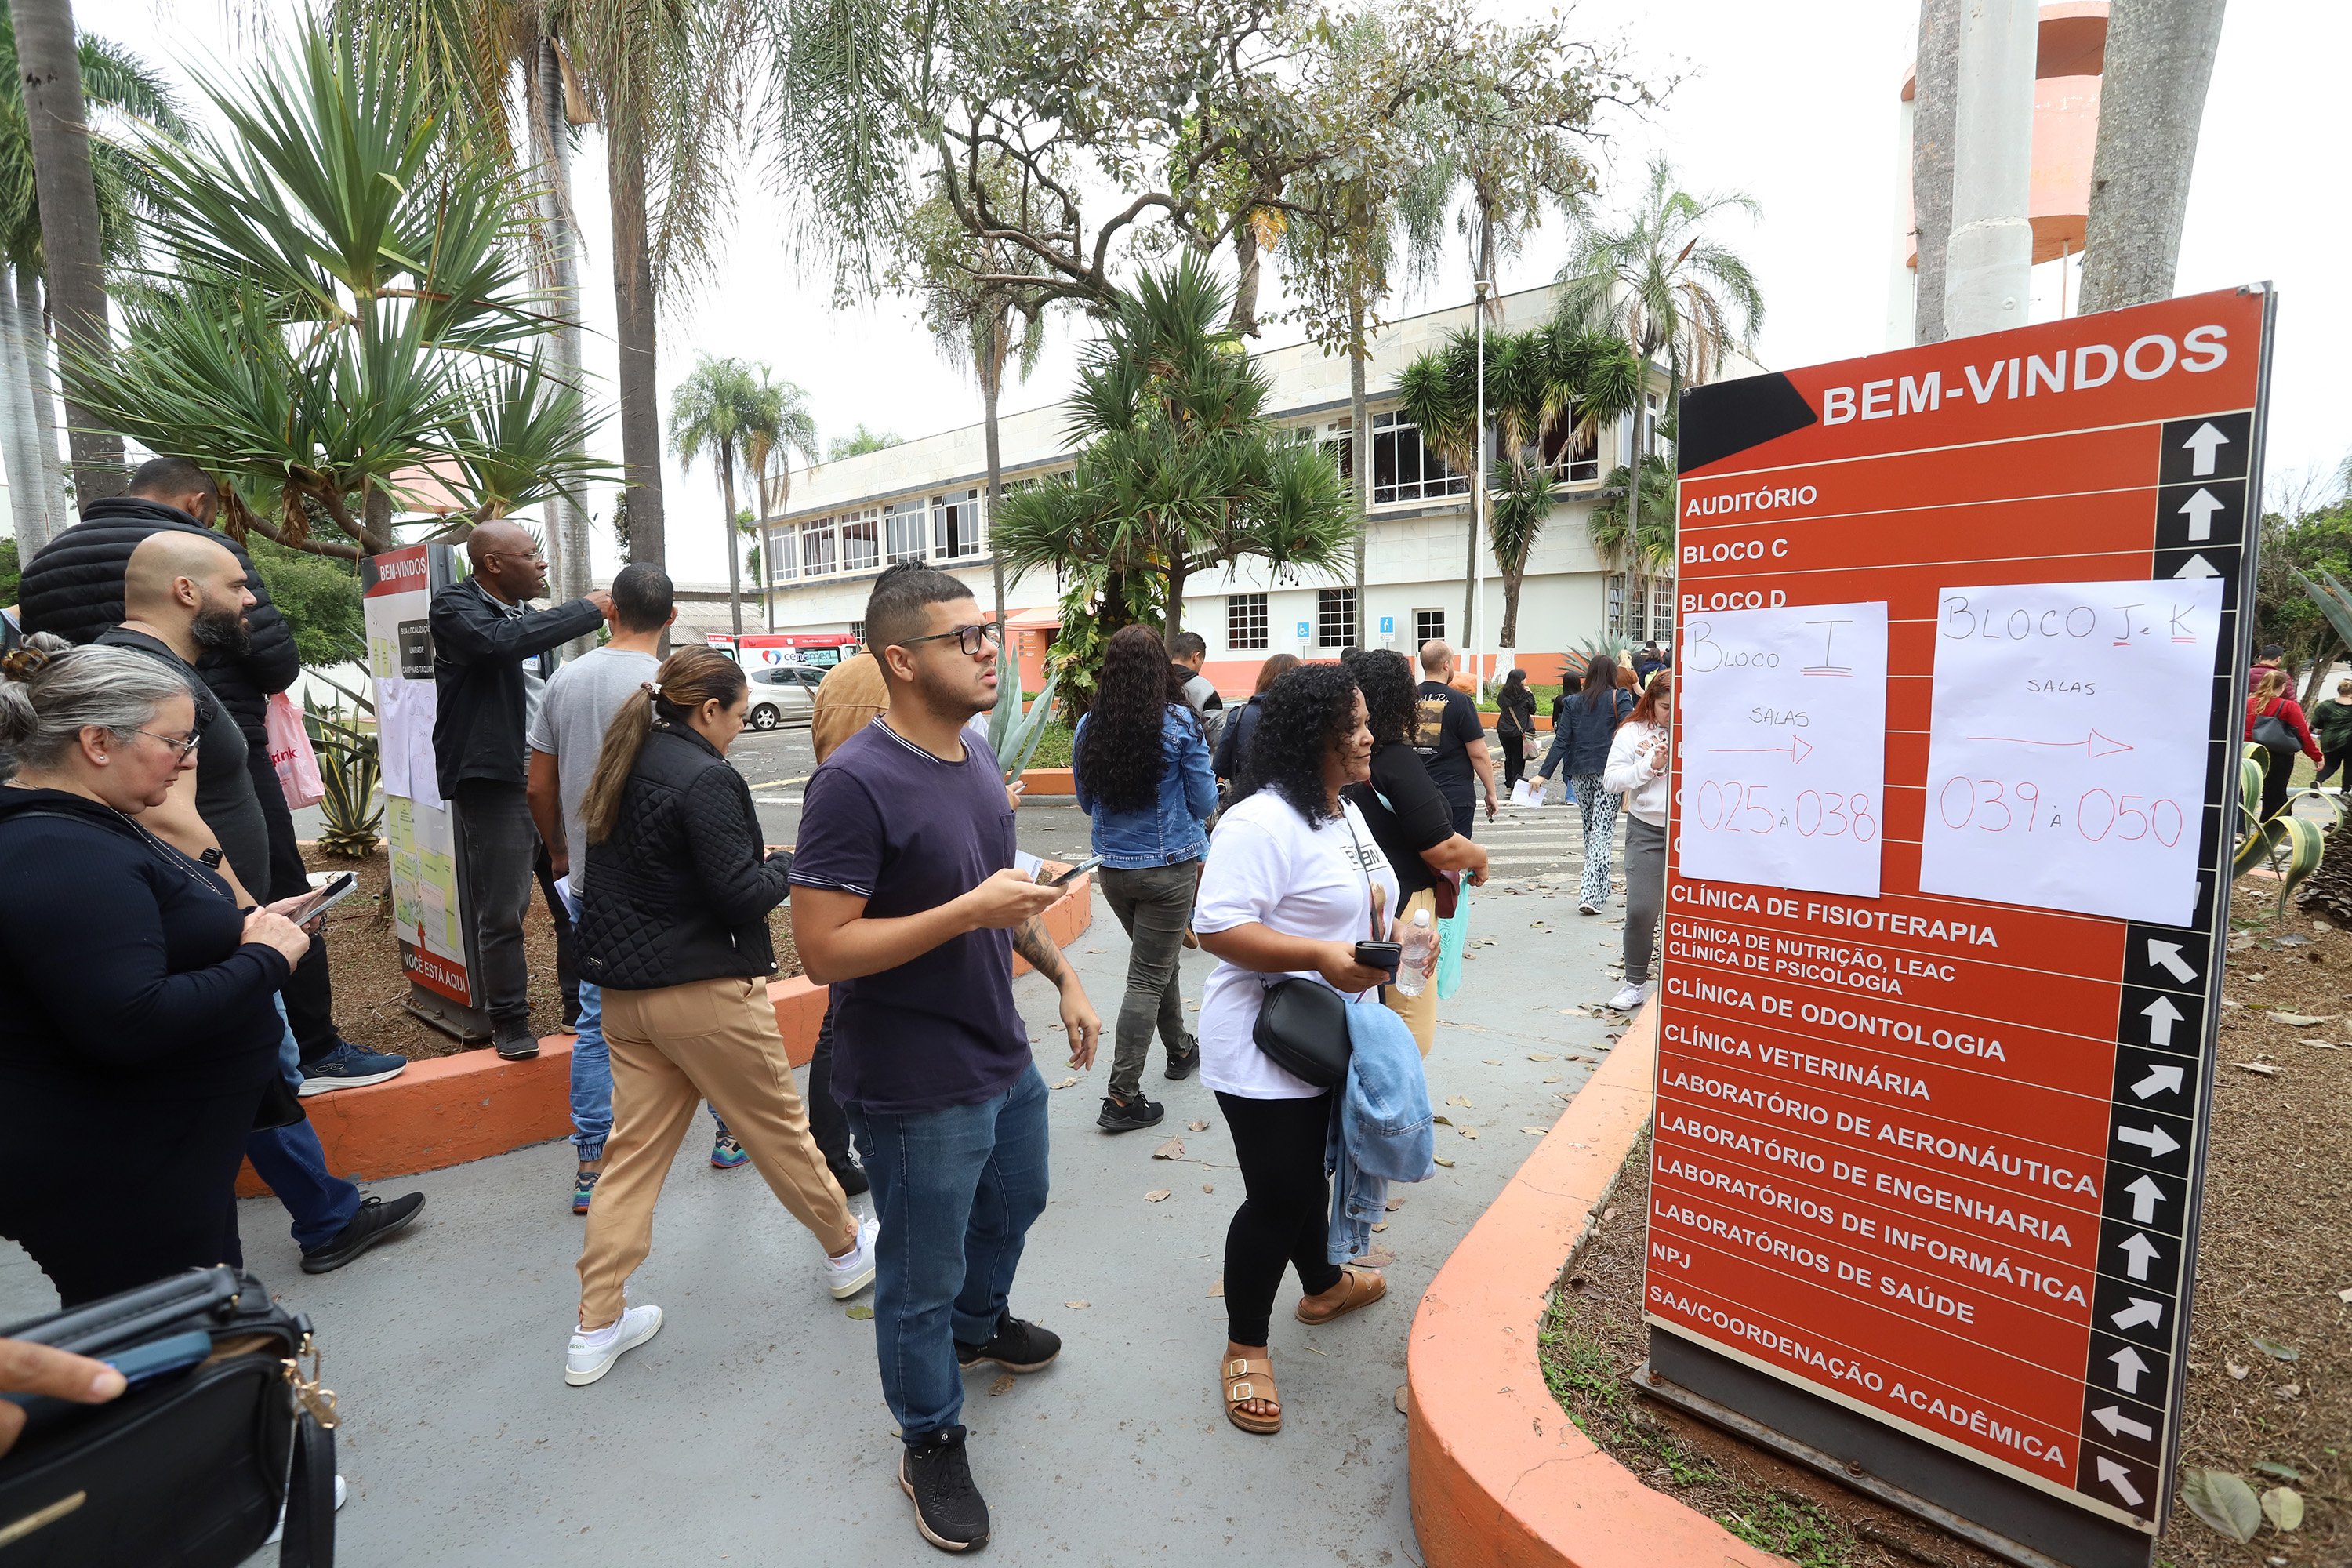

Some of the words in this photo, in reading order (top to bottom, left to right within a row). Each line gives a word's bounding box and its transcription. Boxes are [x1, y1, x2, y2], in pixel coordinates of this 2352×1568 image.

[1824, 325, 2227, 426] BEM-VINDOS
[1686, 486, 1817, 517] AUDITÓRIO
[379, 557, 426, 581] BEM-VINDOS
[1683, 541, 1764, 564] BLOCO
[1772, 539, 1788, 557] C
[1682, 591, 1762, 612] BLOCO
[1770, 589, 1787, 608] D
[1943, 597, 2096, 640] BLOCO
[2114, 603, 2145, 640] J
[2169, 604, 2196, 635] K
[2027, 679, 2096, 695] SALAS
[1748, 707, 1809, 728] SALAS
[1698, 780, 1774, 833] 025
[1796, 789, 1876, 842] 038
[1940, 776, 2038, 832] 039
[2078, 788, 2182, 848] 050
[1671, 884, 1760, 913] CLÍNICA
[1767, 898, 1798, 918] DE
[1807, 903, 1998, 947] FISIOTERAPIA
[404, 954, 423, 974] VOCÊ
[424, 960, 445, 982] ESTÁ
[445, 973, 466, 993] AQUI
[1670, 942, 1739, 966] CLÍNICA
[1744, 954, 1769, 971] DE
[1776, 960, 1902, 995] PSICOLOGIA
[1671, 923, 1740, 946] CLÍNICA
[1746, 934, 1770, 951] DE
[1777, 939, 1887, 973] NUTRIÇÃO,
[1896, 958, 1955, 981] LEAC
[1668, 978, 1755, 1010] CLÍNICA
[1762, 996, 1793, 1018] DE
[1802, 1004, 2005, 1062] ODONTOLOGIA
[1665, 1025, 1751, 1058] CLÍNICA
[1759, 1044, 1929, 1100] VETERINÁRIA
[1663, 1069, 1828, 1124] LABORATÓRIO
[1837, 1112, 1870, 1137] DE
[1877, 1124, 2097, 1198] AERONÁUTICA
[1661, 1112, 1824, 1172] LABORATÓRIO
[1833, 1161, 1867, 1186] DE
[1876, 1173, 2071, 1247] ENGENHARIA
[1653, 1242, 1690, 1269] NPJ
[1658, 1156, 1833, 1224] LABORATÓRIOS
[1842, 1213, 1875, 1238] DE
[1885, 1225, 2086, 1307] INFORMÁTICA
[1655, 1200, 1829, 1272] LABORATÓRIOS
[1838, 1261, 1871, 1288] DE
[1880, 1277, 1973, 1324] SAÚDE
[1650, 1286, 1882, 1391] SAA/COORDENAÇÃO
[1889, 1383, 2065, 1468] ACADÊMICA
